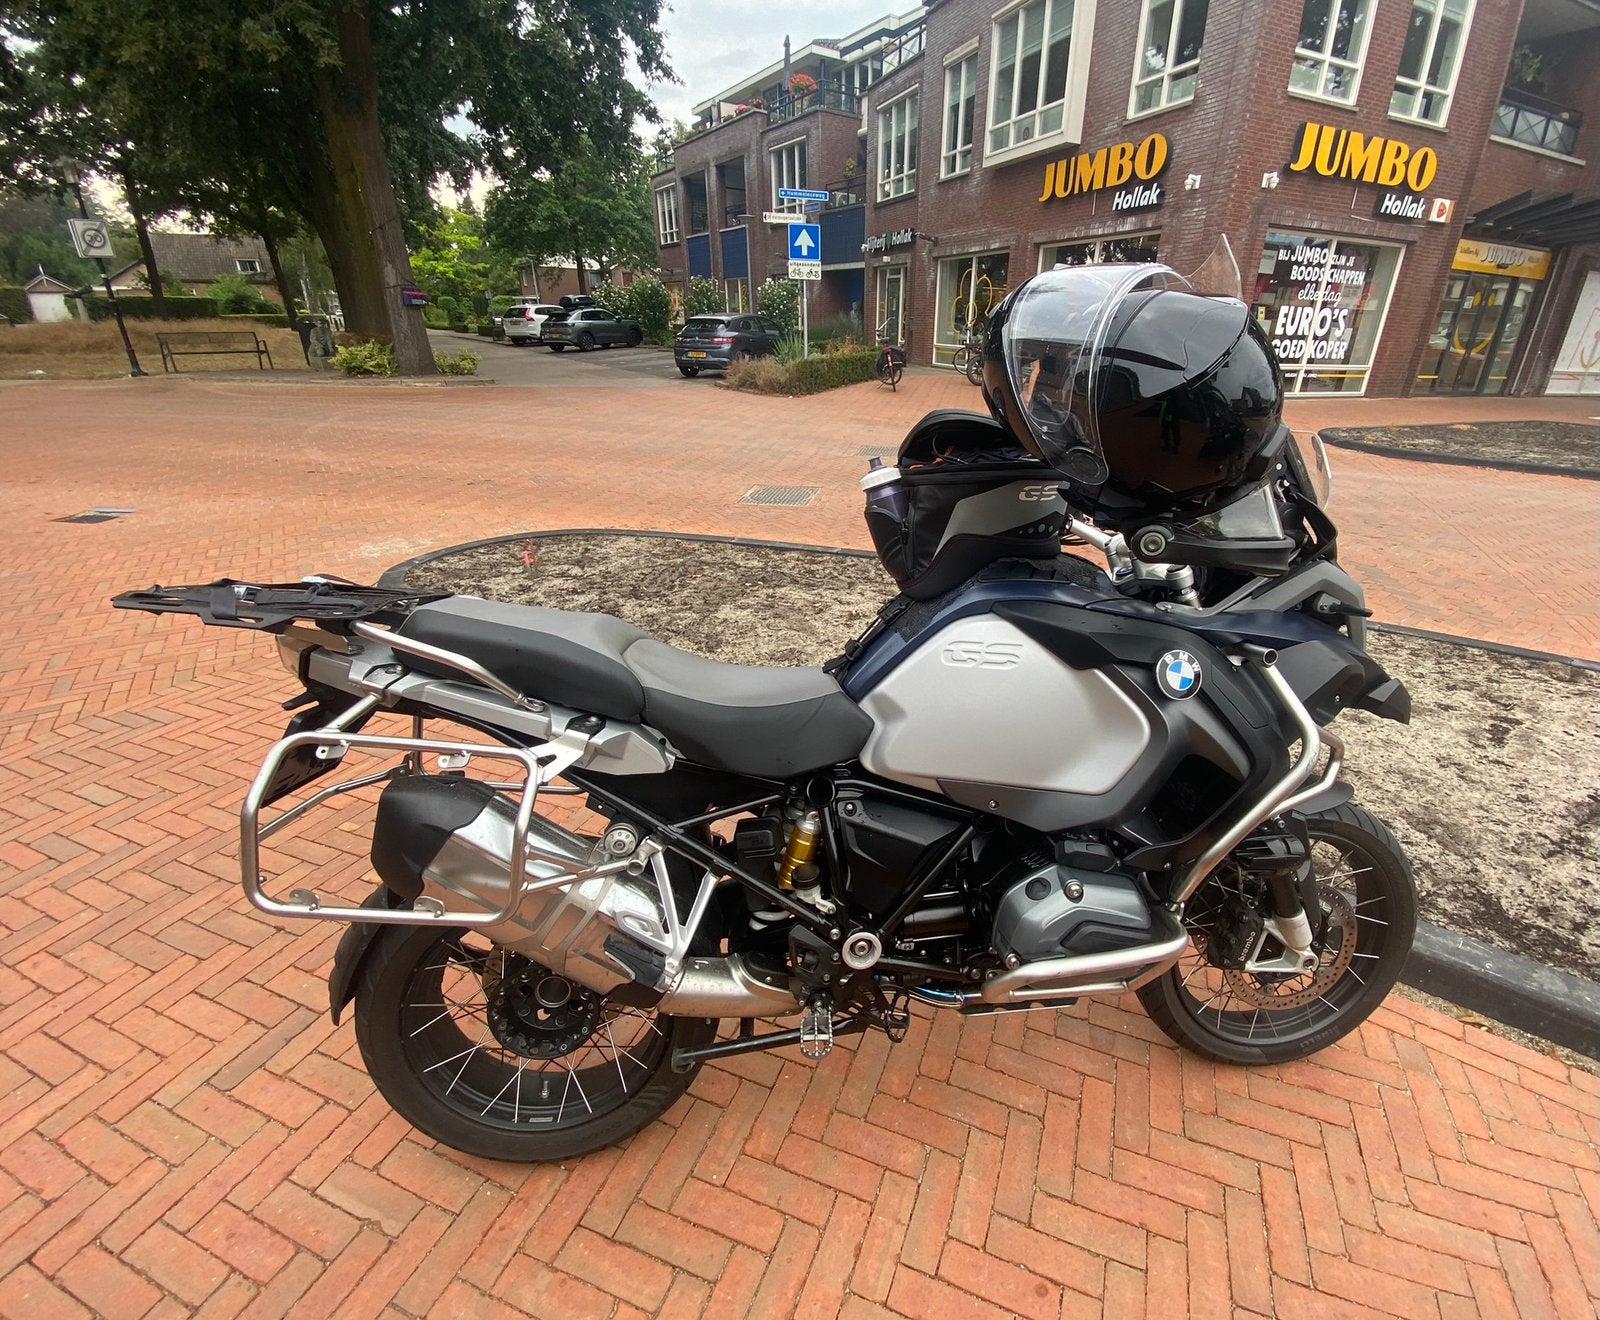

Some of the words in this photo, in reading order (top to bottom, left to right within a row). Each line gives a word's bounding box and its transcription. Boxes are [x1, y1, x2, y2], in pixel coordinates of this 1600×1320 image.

[1038, 132, 1168, 203] JUMBO
[1290, 122, 1438, 192] JUMBO
[1112, 183, 1161, 212] Hollak
[1379, 193, 1426, 220] Hollak
[891, 227, 913, 246] Hollak
[1278, 248, 1292, 261] BIJ
[1291, 245, 1329, 265] JUMBO
[1346, 255, 1356, 267] JE
[1480, 245, 1526, 267] JUMBO
[1297, 283, 1320, 301] elke
[1321, 285, 1342, 307] dag
[1018, 484, 1059, 502] GS
[941, 640, 1024, 671] GS
[1238, 931, 1256, 962] brembo
